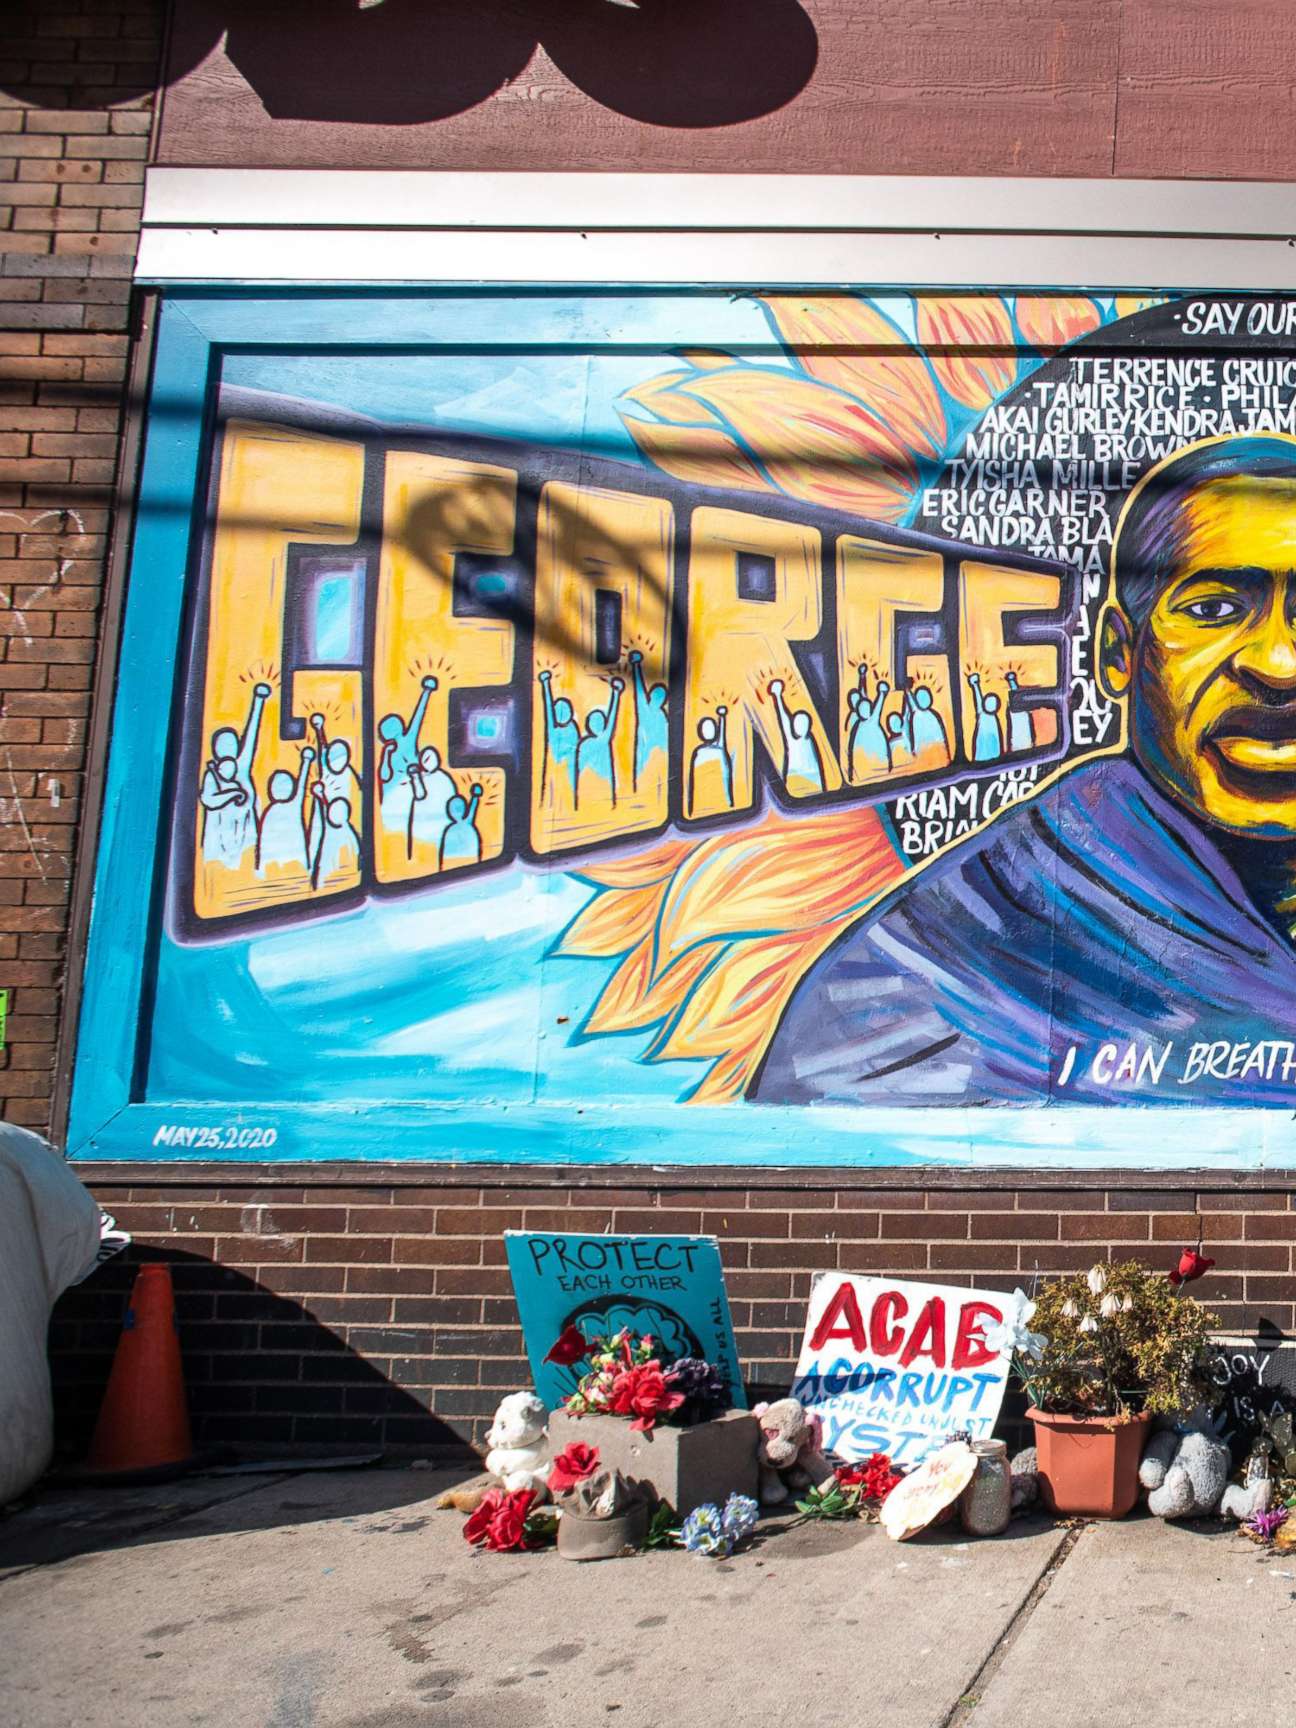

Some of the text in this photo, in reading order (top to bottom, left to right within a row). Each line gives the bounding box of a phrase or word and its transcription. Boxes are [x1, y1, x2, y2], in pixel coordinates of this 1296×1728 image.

[1182, 302, 1244, 335] SAY
[1070, 357, 1216, 387] TERRENCE
[1033, 382, 1122, 413] TAMIR
[1124, 384, 1195, 412] RICE
[979, 405, 1039, 435] AKAI
[966, 433, 1087, 462] MICHAEL
[944, 458, 1041, 492] TYISHA
[922, 488, 1108, 519] ERIC GARNER
[941, 515, 1053, 545] SANDRA
[190, 415, 1067, 926] GEORGE
[1058, 1046, 1076, 1087] I
[1091, 1041, 1172, 1085] CAN
[528, 1237, 700, 1276] PROTECT
[557, 1274, 688, 1292] EACH OTHER
[809, 1281, 1004, 1371] ACAB
[1212, 1354, 1270, 1386] JOY
